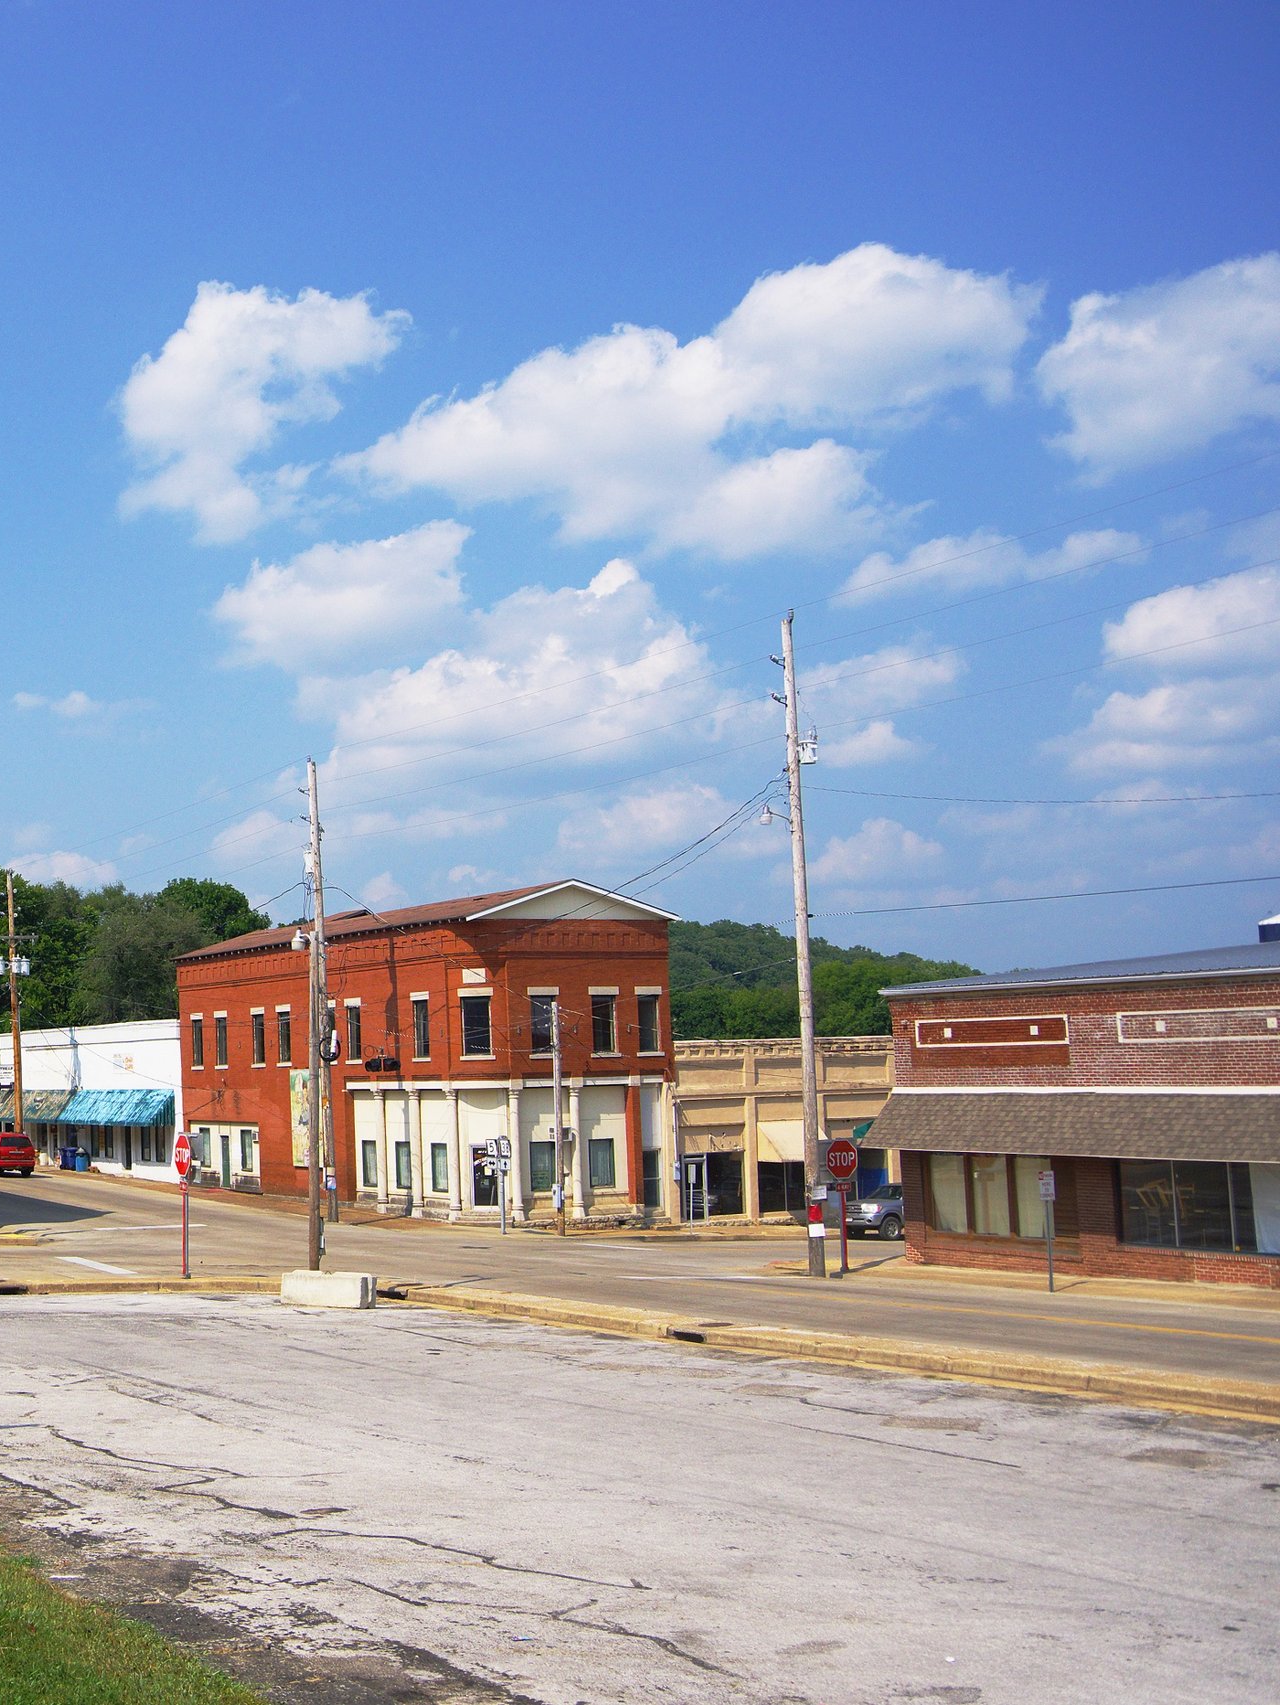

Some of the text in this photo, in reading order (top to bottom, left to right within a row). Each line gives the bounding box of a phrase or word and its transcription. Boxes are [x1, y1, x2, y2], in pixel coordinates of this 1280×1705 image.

[489, 1142, 495, 1153] 5
[175, 1148, 190, 1163] STOP
[829, 1152, 855, 1167] STOP
